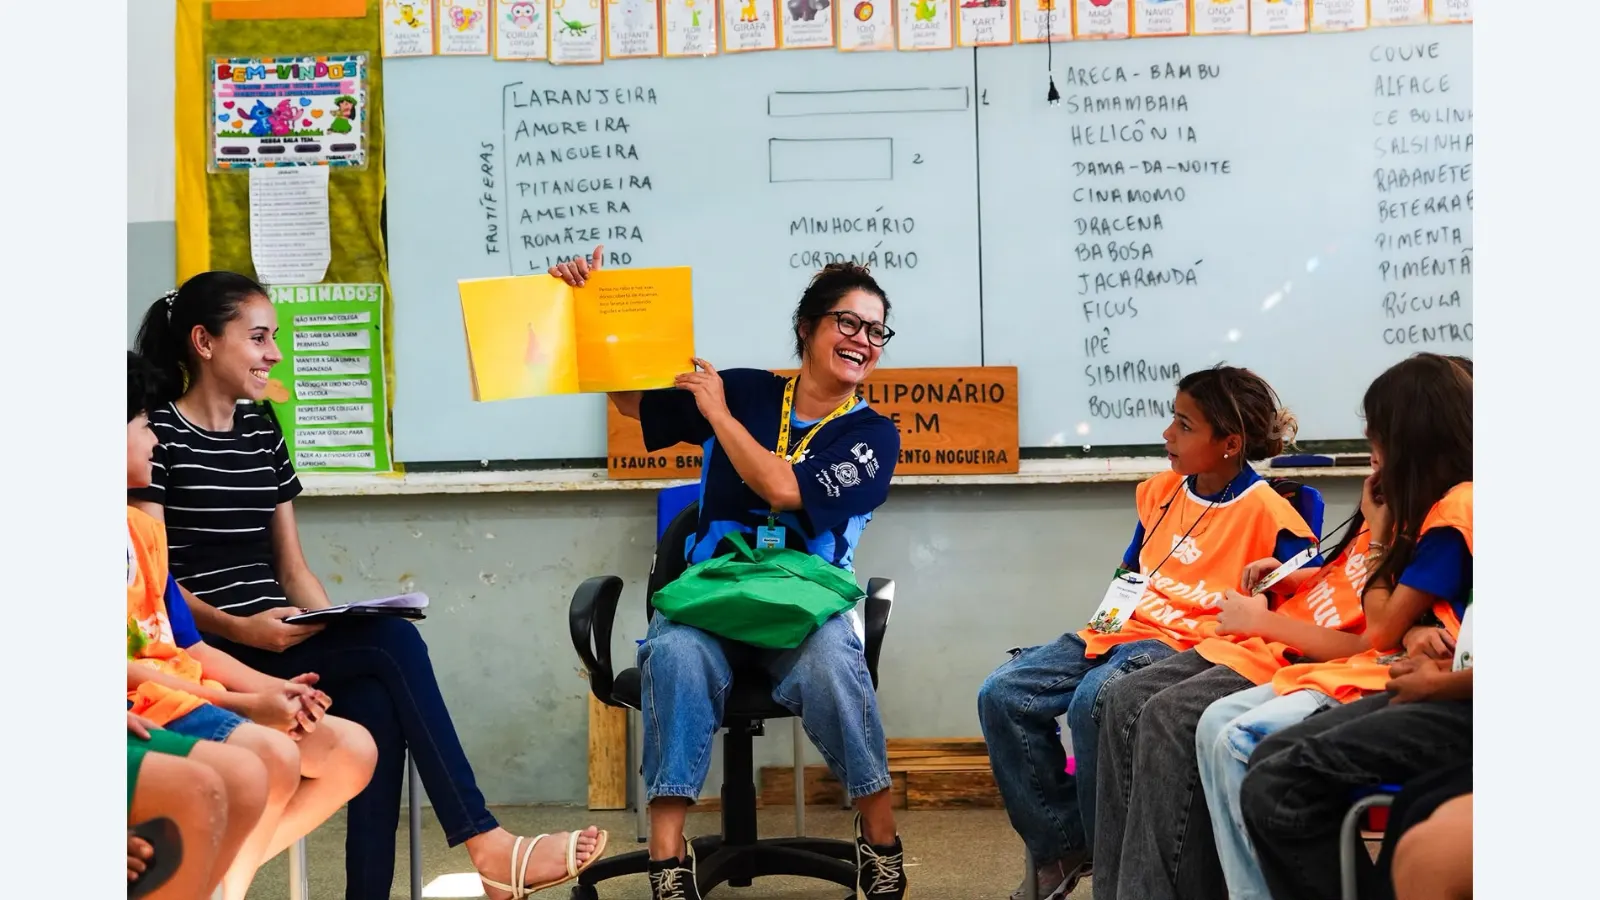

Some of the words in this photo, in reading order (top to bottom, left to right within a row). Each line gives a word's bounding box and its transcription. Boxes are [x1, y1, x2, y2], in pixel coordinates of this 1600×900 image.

[972, 18, 997, 27] KART
[1088, 7, 1113, 18] MAÇÃ
[1145, 8, 1174, 17] NAVIO
[506, 31, 539, 40] CORUJA
[733, 23, 767, 32] GIRAFA
[1369, 42, 1440, 62] COUVE
[217, 61, 358, 82] BEM-VINDOS
[1067, 65, 1127, 86] ARECA
[1150, 62, 1220, 81] BAMBU
[512, 86, 658, 107] LARANJEIRA
[1374, 73, 1451, 97] ALFACE
[1067, 94, 1188, 114] SAMAMBAIA
[514, 116, 630, 141] AMOREIRA
[1071, 118, 1197, 146] HELICÔNIA
[515, 143, 639, 168] MANGUEIRA
[912, 153, 924, 165] 2
[515, 175, 653, 197] PITANGUEIRA
[1373, 163, 1472, 192] RABANETE
[479, 141, 500, 256] FRUTÍFERAS
[1073, 186, 1186, 204] CINAMOMO
[519, 200, 631, 225] AMEIXERA
[789, 205, 916, 236] MINHOCÁRIO
[1074, 213, 1164, 236] DRACENA
[520, 225, 645, 249] ROMÃZEIRA
[1374, 226, 1462, 251] PIMENTA
[788, 240, 919, 269] CORDONÁRIO
[1074, 240, 1154, 262] BABOSA
[1378, 247, 1473, 281] PIMENTÃ
[1077, 259, 1203, 295] JACARANDÁ
[269, 285, 378, 304] OMBINADOS
[1382, 290, 1461, 319] RÚCULA
[1083, 296, 1138, 323] FICUS
[1084, 326, 1110, 358] IPÊ
[1383, 322, 1473, 344] COENTRO
[1085, 359, 1182, 387] SIBIPIRUNA
[856, 377, 1006, 404] ELIPONÁRIO
[612, 456, 667, 469] ISAURO
[675, 455, 703, 468] BEN
[898, 449, 931, 464] ENTO
[936, 449, 1008, 464] NOGUEIRA
